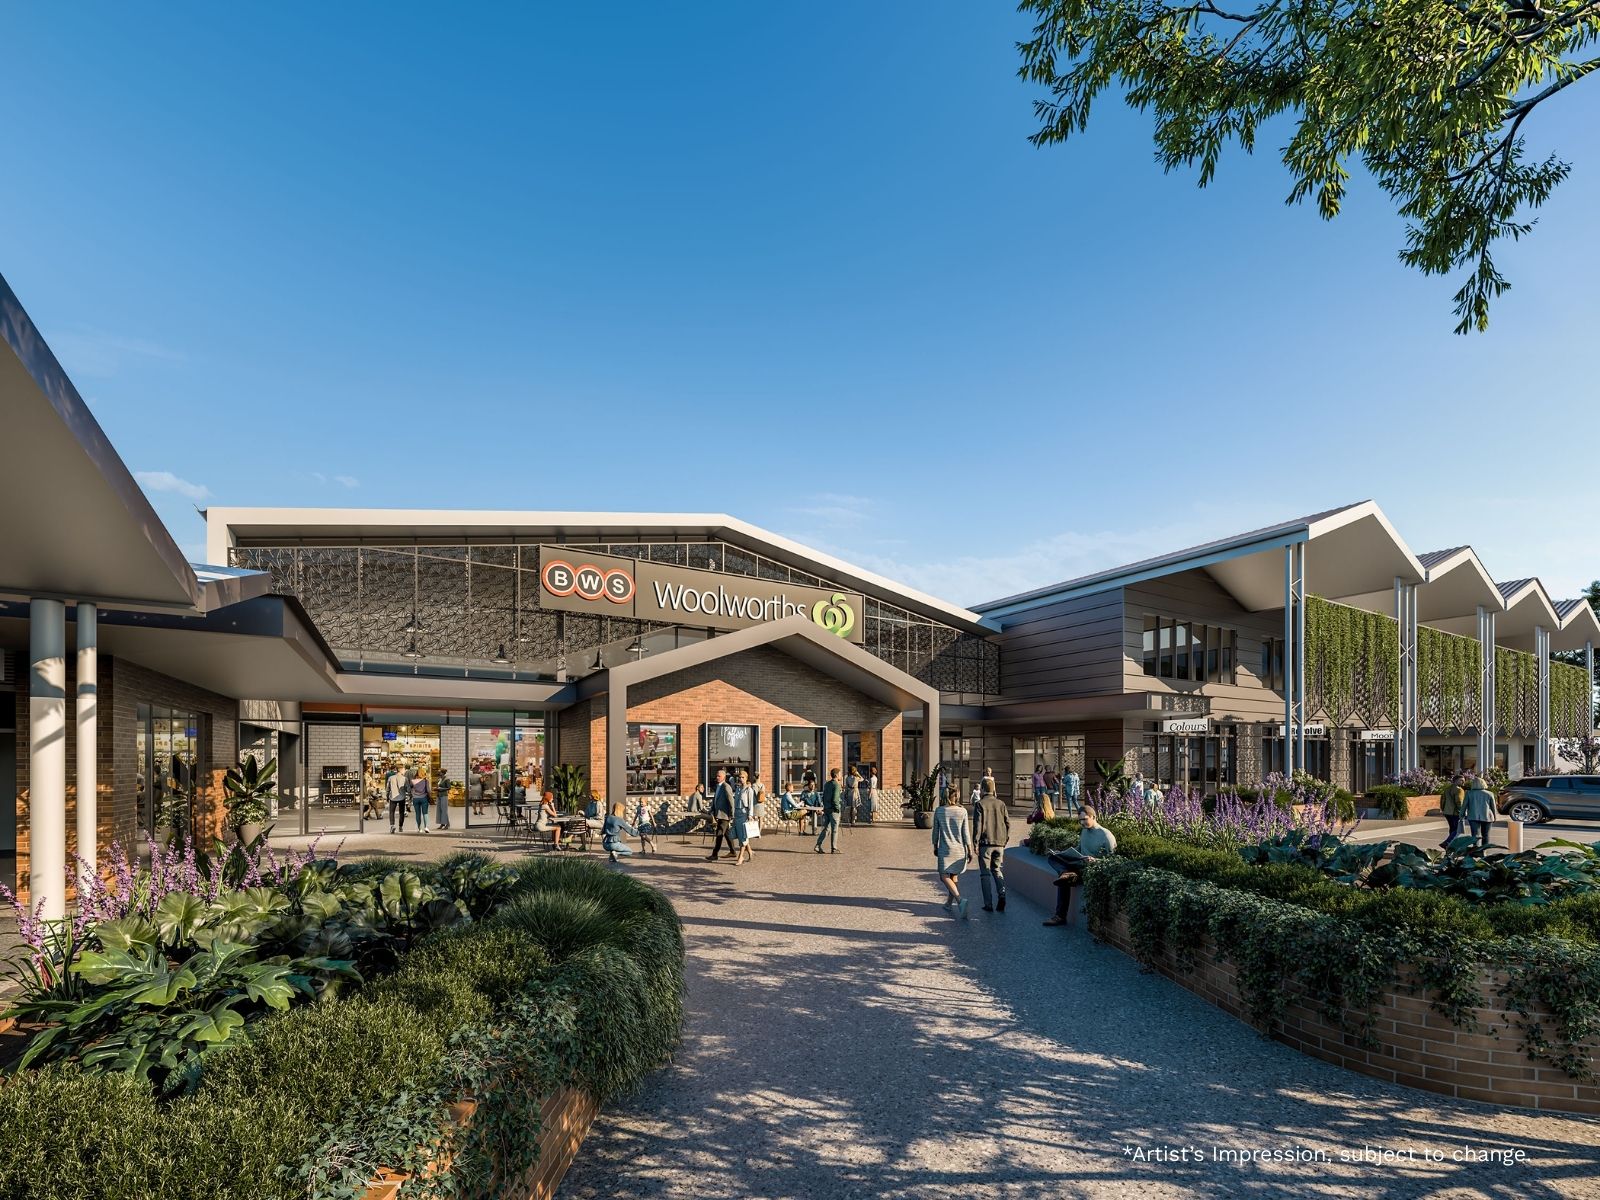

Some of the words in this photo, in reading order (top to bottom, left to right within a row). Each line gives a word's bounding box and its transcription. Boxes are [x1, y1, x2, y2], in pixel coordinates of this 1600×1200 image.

[554, 569, 625, 594] BWS
[653, 580, 807, 622] Woolworths
[1169, 721, 1207, 732] Colours
[1291, 726, 1323, 735] Rolve
